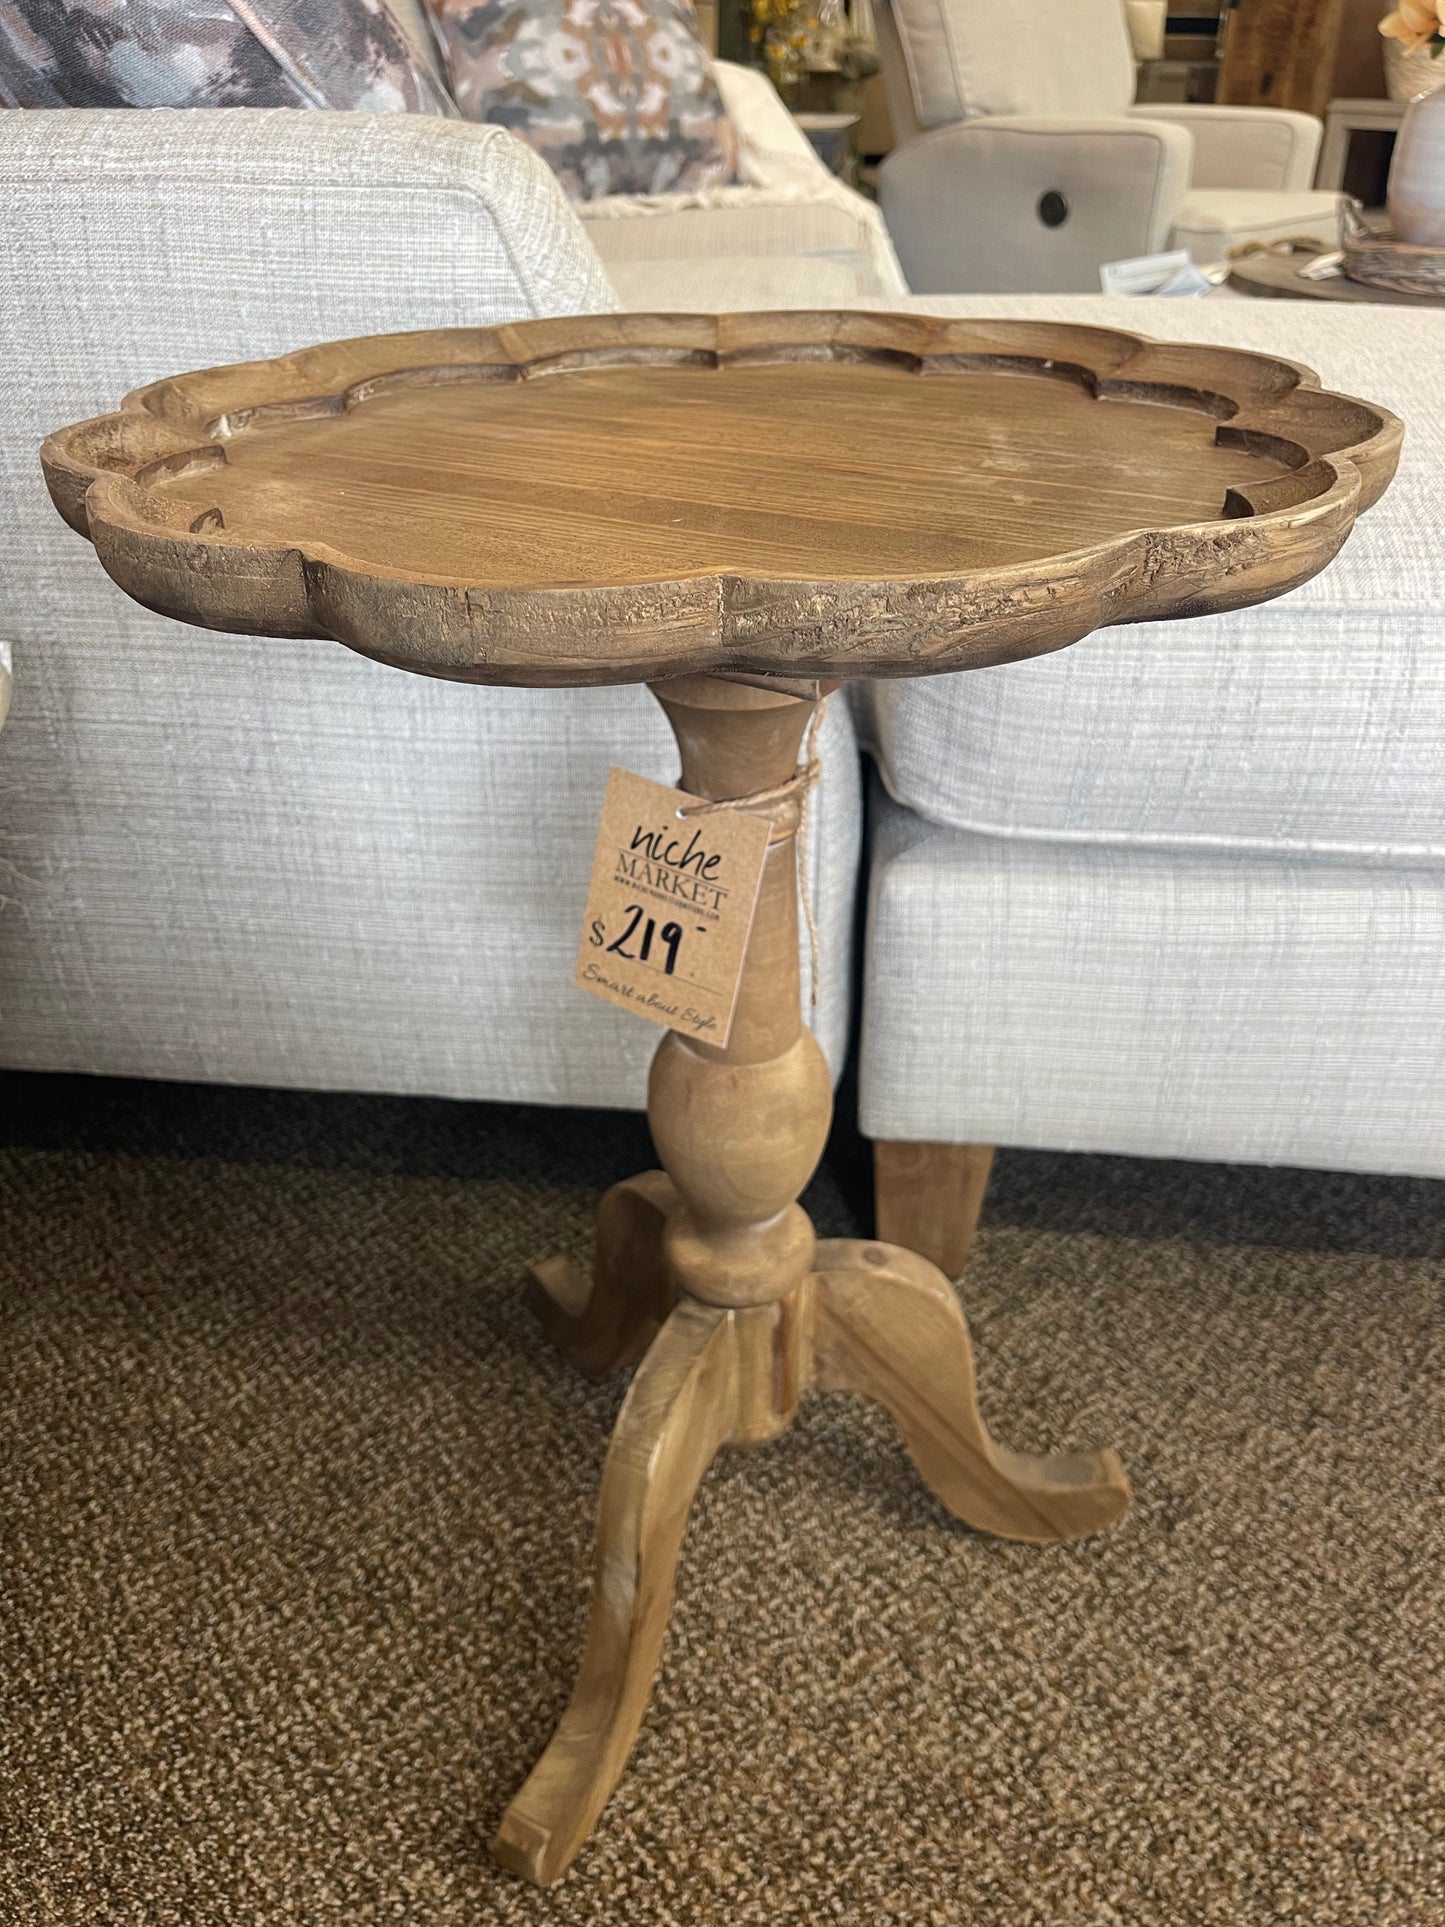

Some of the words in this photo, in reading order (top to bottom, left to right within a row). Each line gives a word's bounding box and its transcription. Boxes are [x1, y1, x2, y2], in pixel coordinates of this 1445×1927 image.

[616, 853, 728, 911] MARKET
[630, 825, 721, 881] niche
[583, 963, 634, 997] Smart
[635, 992, 678, 1016] about
[681, 1007, 717, 1031] Style
